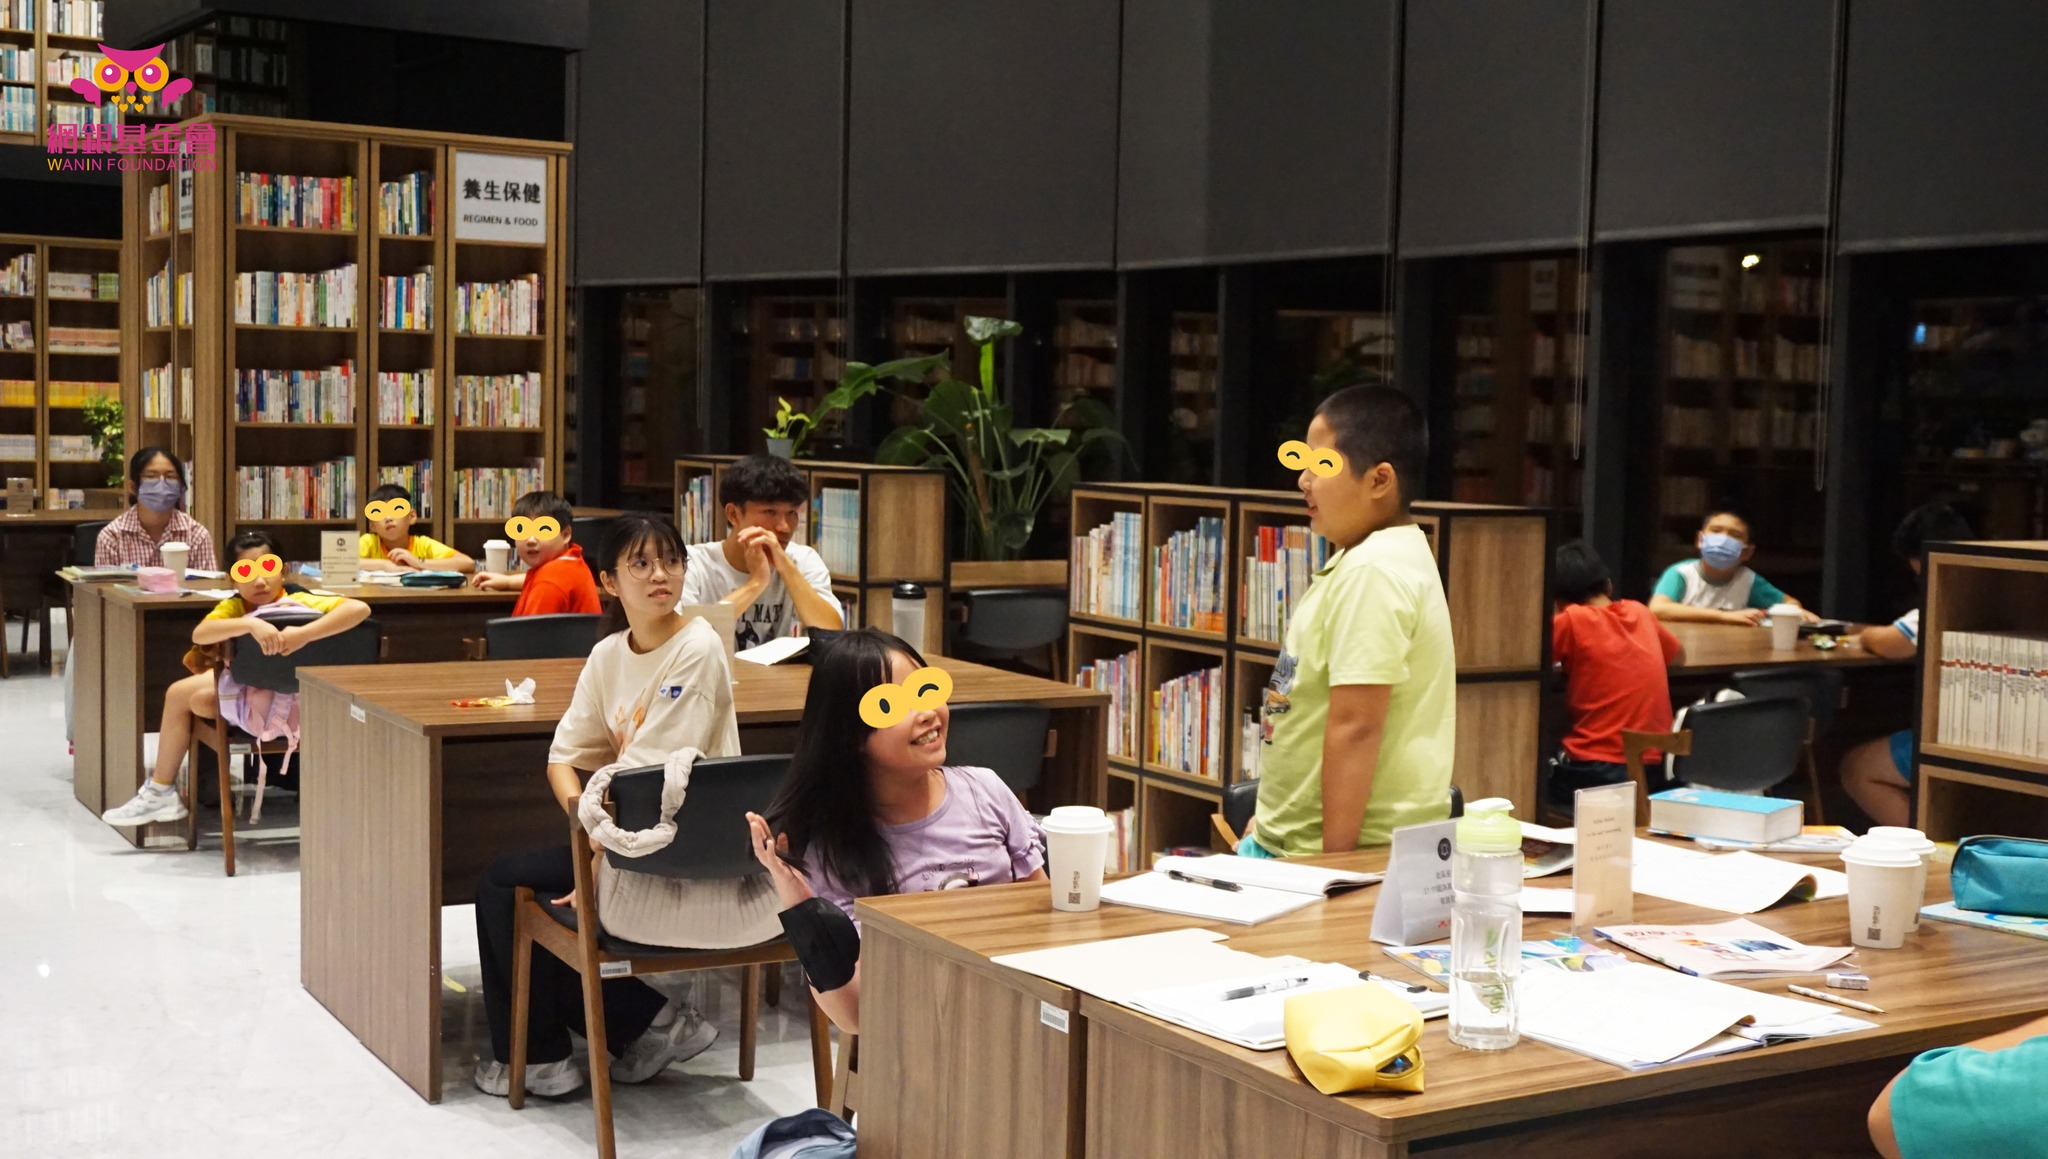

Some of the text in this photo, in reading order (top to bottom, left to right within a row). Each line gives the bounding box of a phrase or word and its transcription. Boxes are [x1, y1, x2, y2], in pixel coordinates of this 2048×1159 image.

[463, 178, 541, 204] 養生保健
[463, 214, 502, 224] REGIMEN
[514, 217, 538, 226] FOOD
